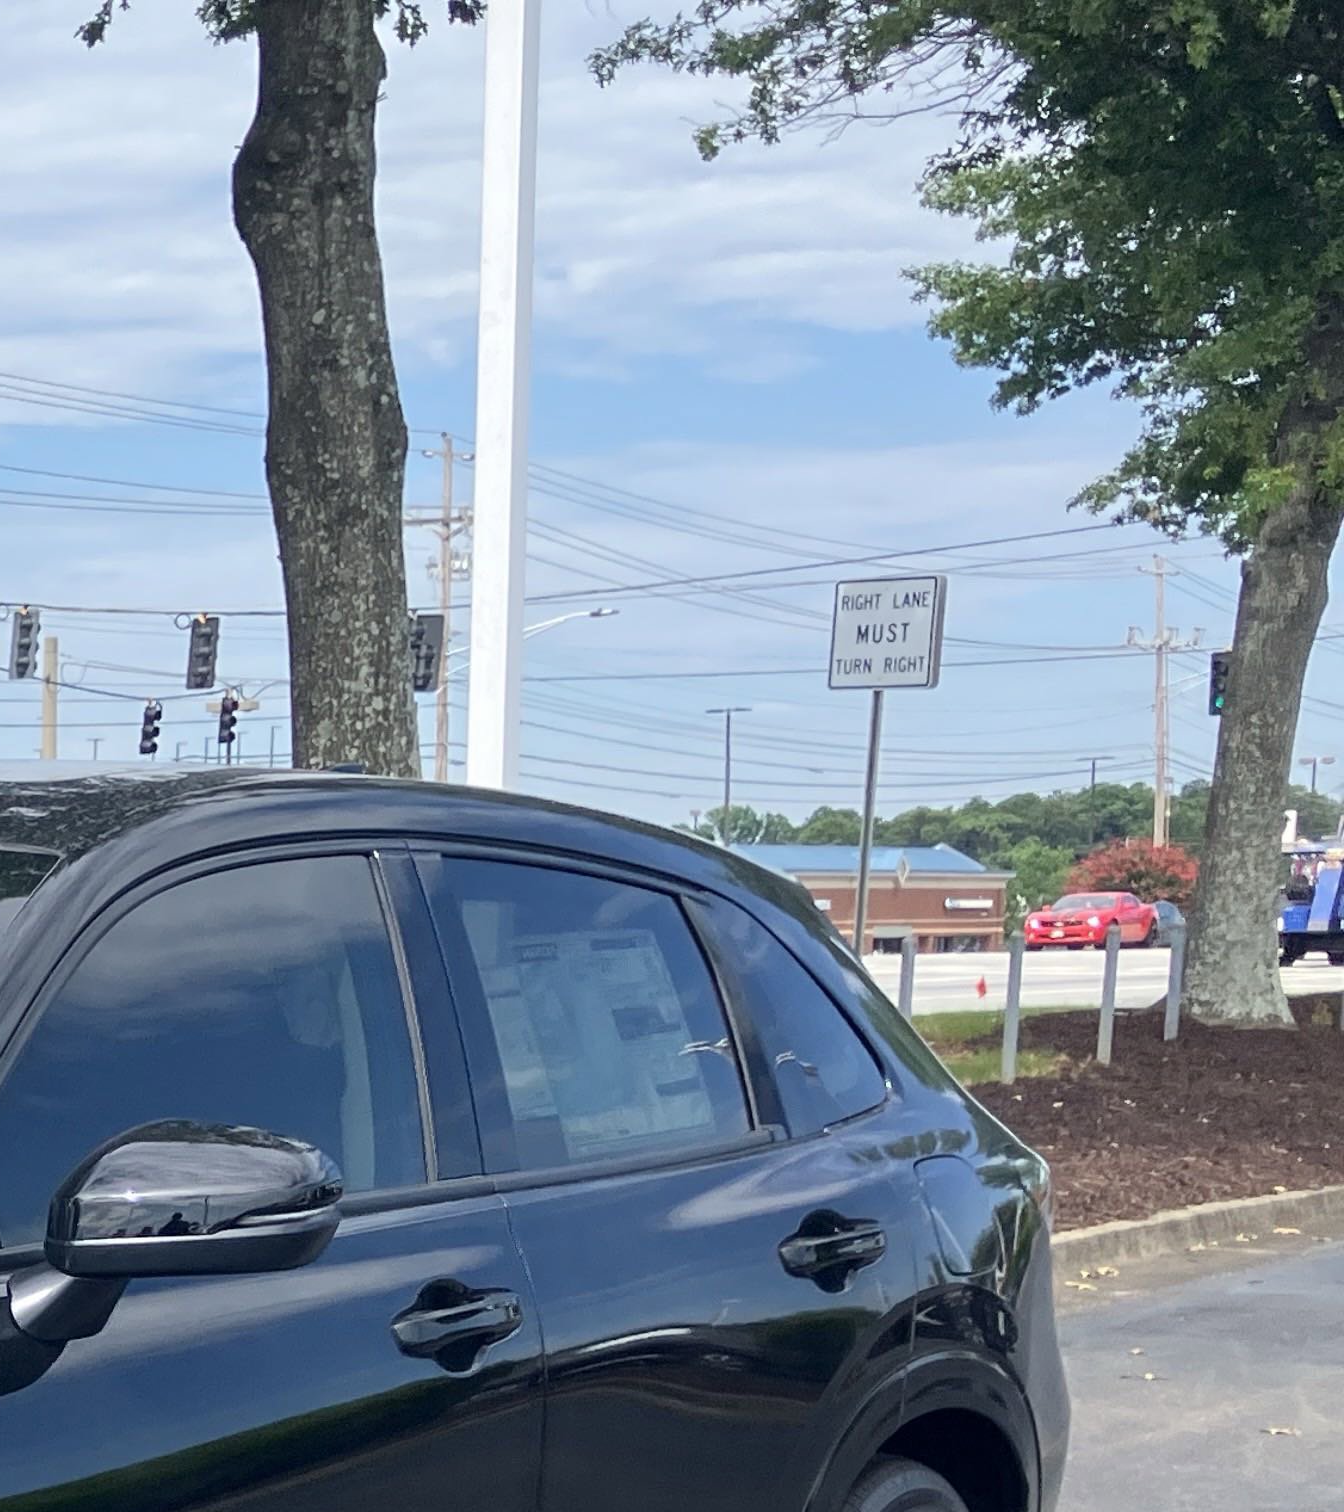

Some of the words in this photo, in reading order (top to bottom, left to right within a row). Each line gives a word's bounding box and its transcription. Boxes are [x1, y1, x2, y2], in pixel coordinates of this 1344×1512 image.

[841, 593, 882, 611] RIGHT
[892, 590, 931, 609] LANE
[856, 622, 910, 644] MUST
[836, 658, 872, 675] TURN
[883, 656, 925, 674] RIGHT
